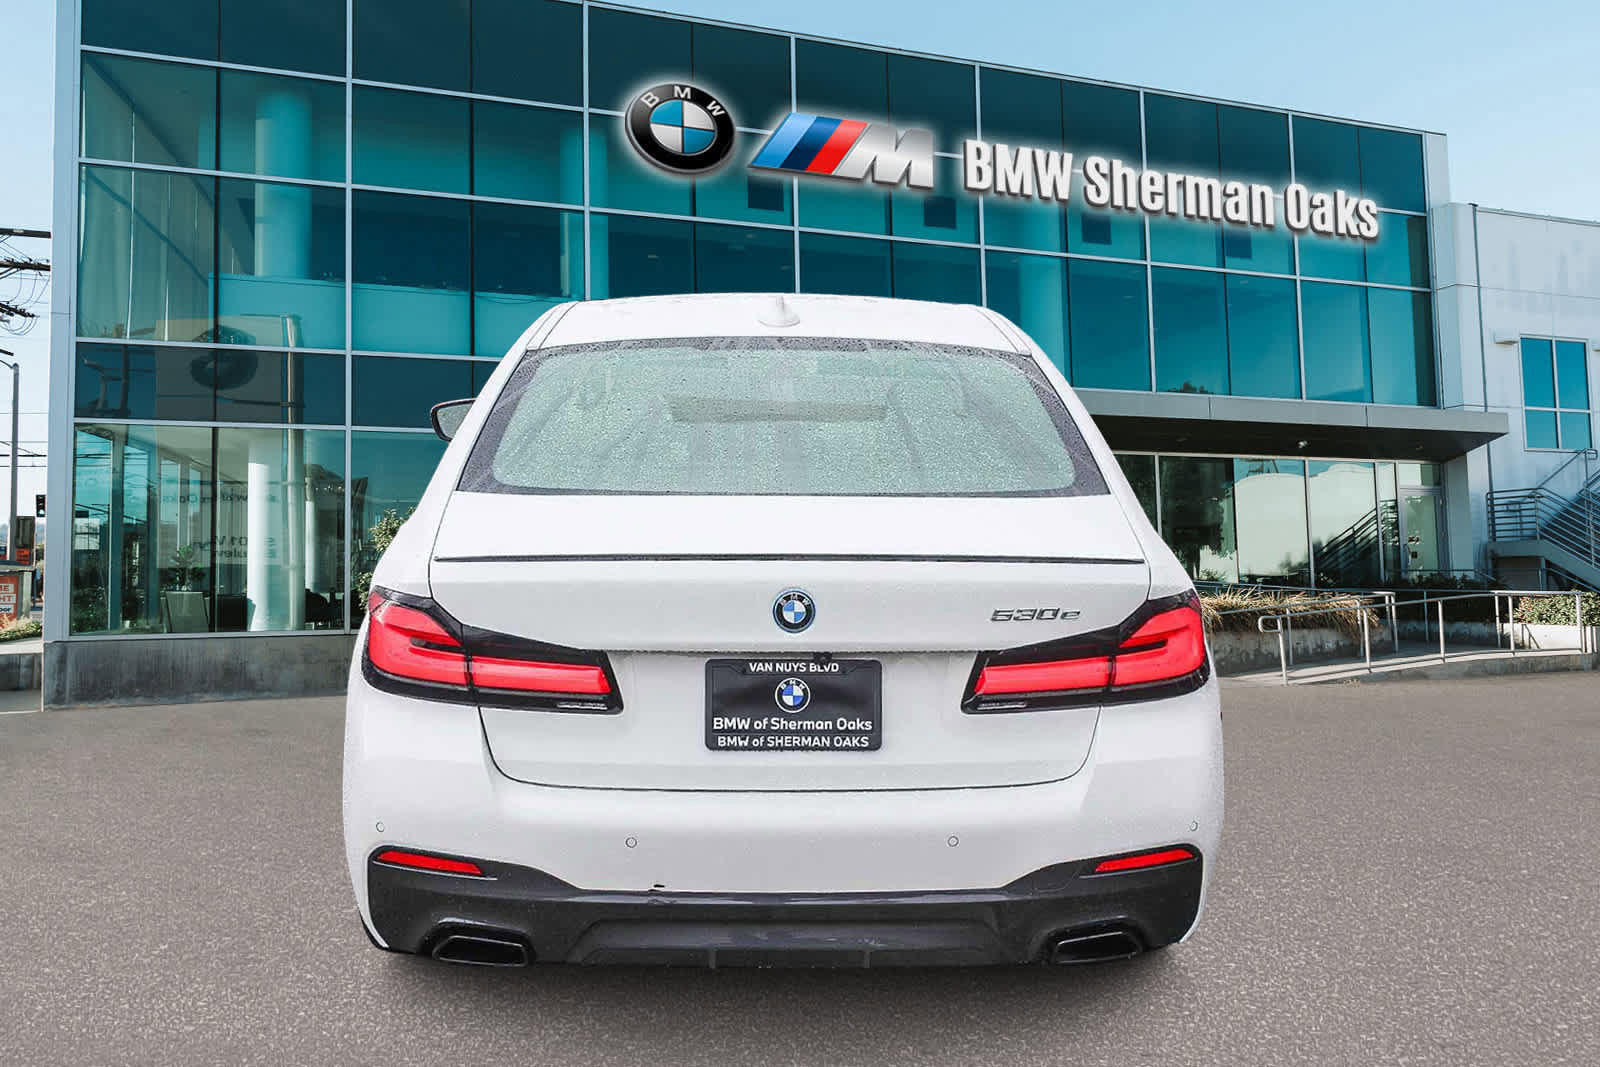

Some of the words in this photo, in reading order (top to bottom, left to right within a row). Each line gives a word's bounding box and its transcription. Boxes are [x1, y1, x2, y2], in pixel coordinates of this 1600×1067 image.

[640, 84, 726, 118] BMW
[963, 139, 1073, 201] BMW
[1083, 156, 1275, 226] Sherman
[1284, 183, 1379, 240] Oaks
[990, 608, 1081, 622] 530e
[749, 662, 773, 673] VAN
[775, 662, 806, 673] NUYS
[809, 662, 839, 673] BLVD
[713, 717, 750, 730] BMW
[753, 717, 768, 730] of
[770, 717, 833, 730] Sherman
[836, 717, 873, 730] Oaks
[717, 736, 749, 747] BMW
[752, 736, 765, 747] of
[767, 736, 830, 747] SHERMAN
[833, 736, 869, 747] OAKS
